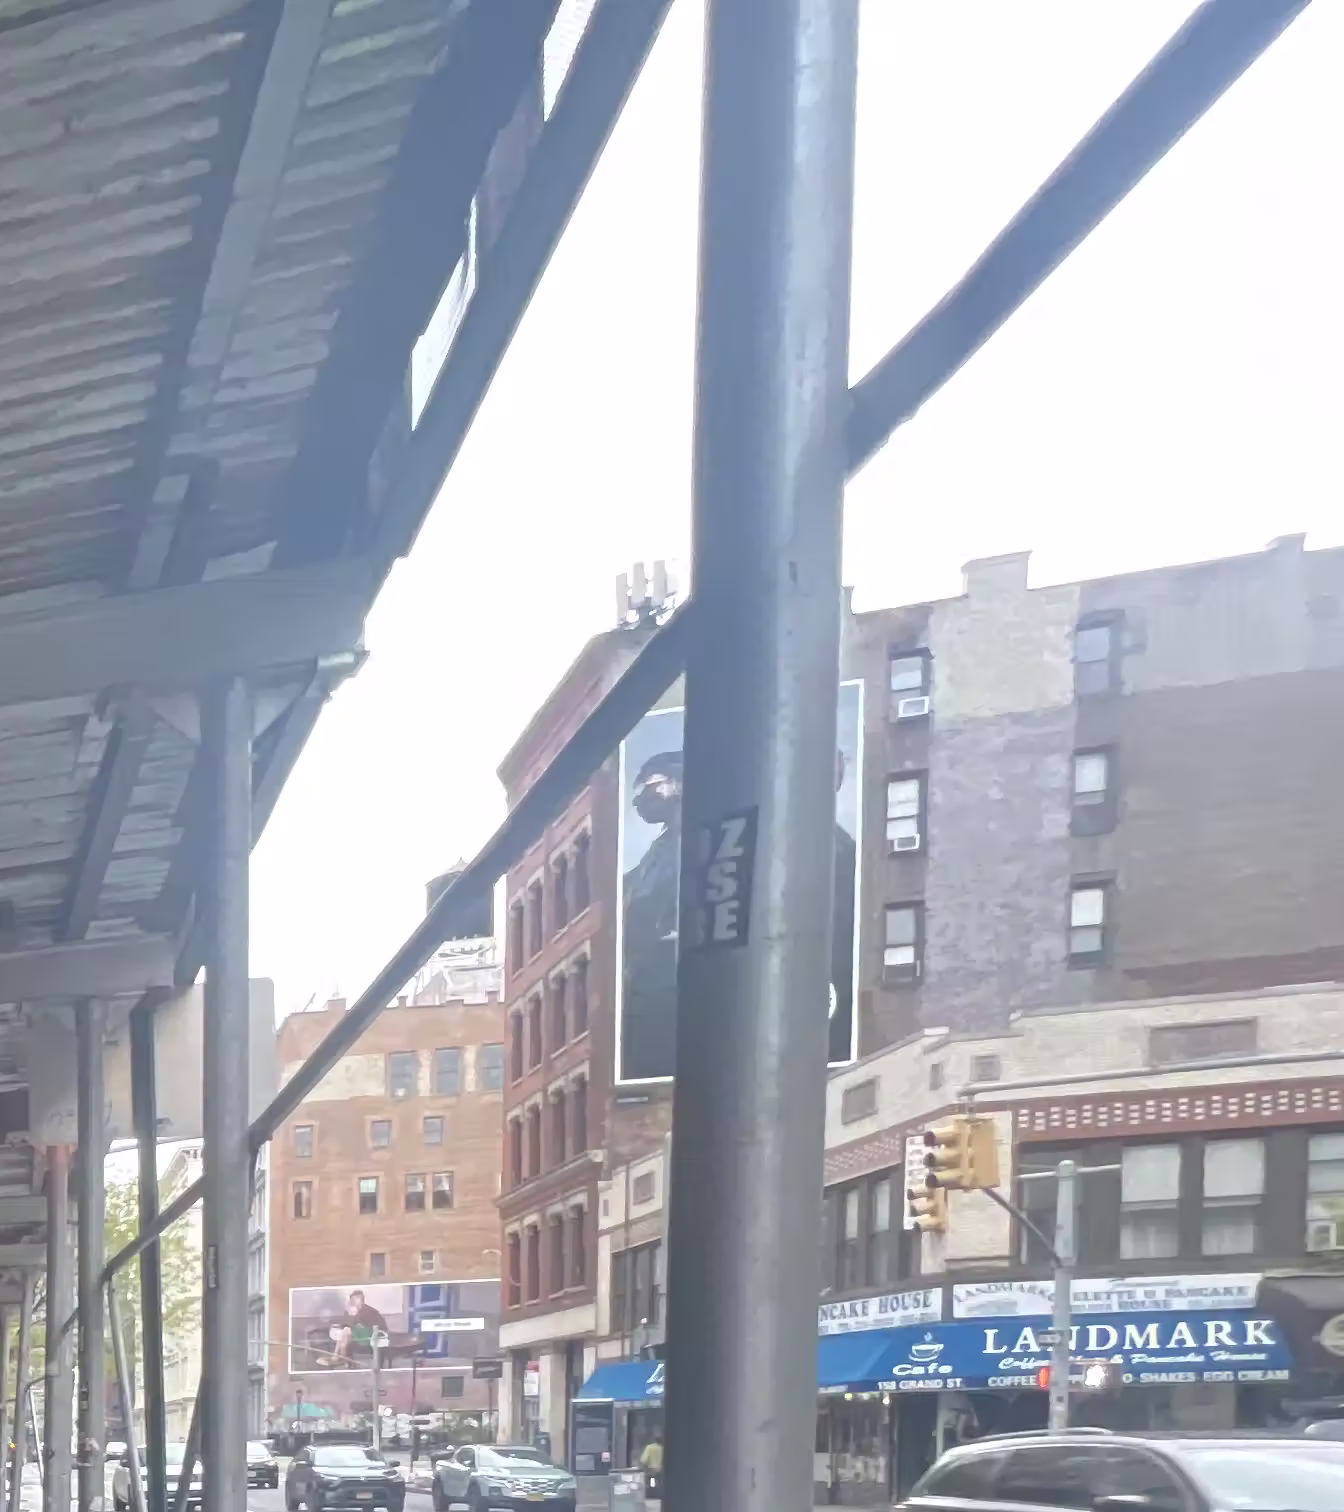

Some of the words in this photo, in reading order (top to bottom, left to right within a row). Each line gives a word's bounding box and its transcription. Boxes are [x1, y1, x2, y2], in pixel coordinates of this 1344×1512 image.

[878, 1290, 933, 1314] HOUSE
[892, 1362, 953, 1376] Cafe
[899, 1379, 943, 1390] GRAND
[987, 1374, 1038, 1387] COFFEE
[1139, 1371, 1196, 1383] SHAKES
